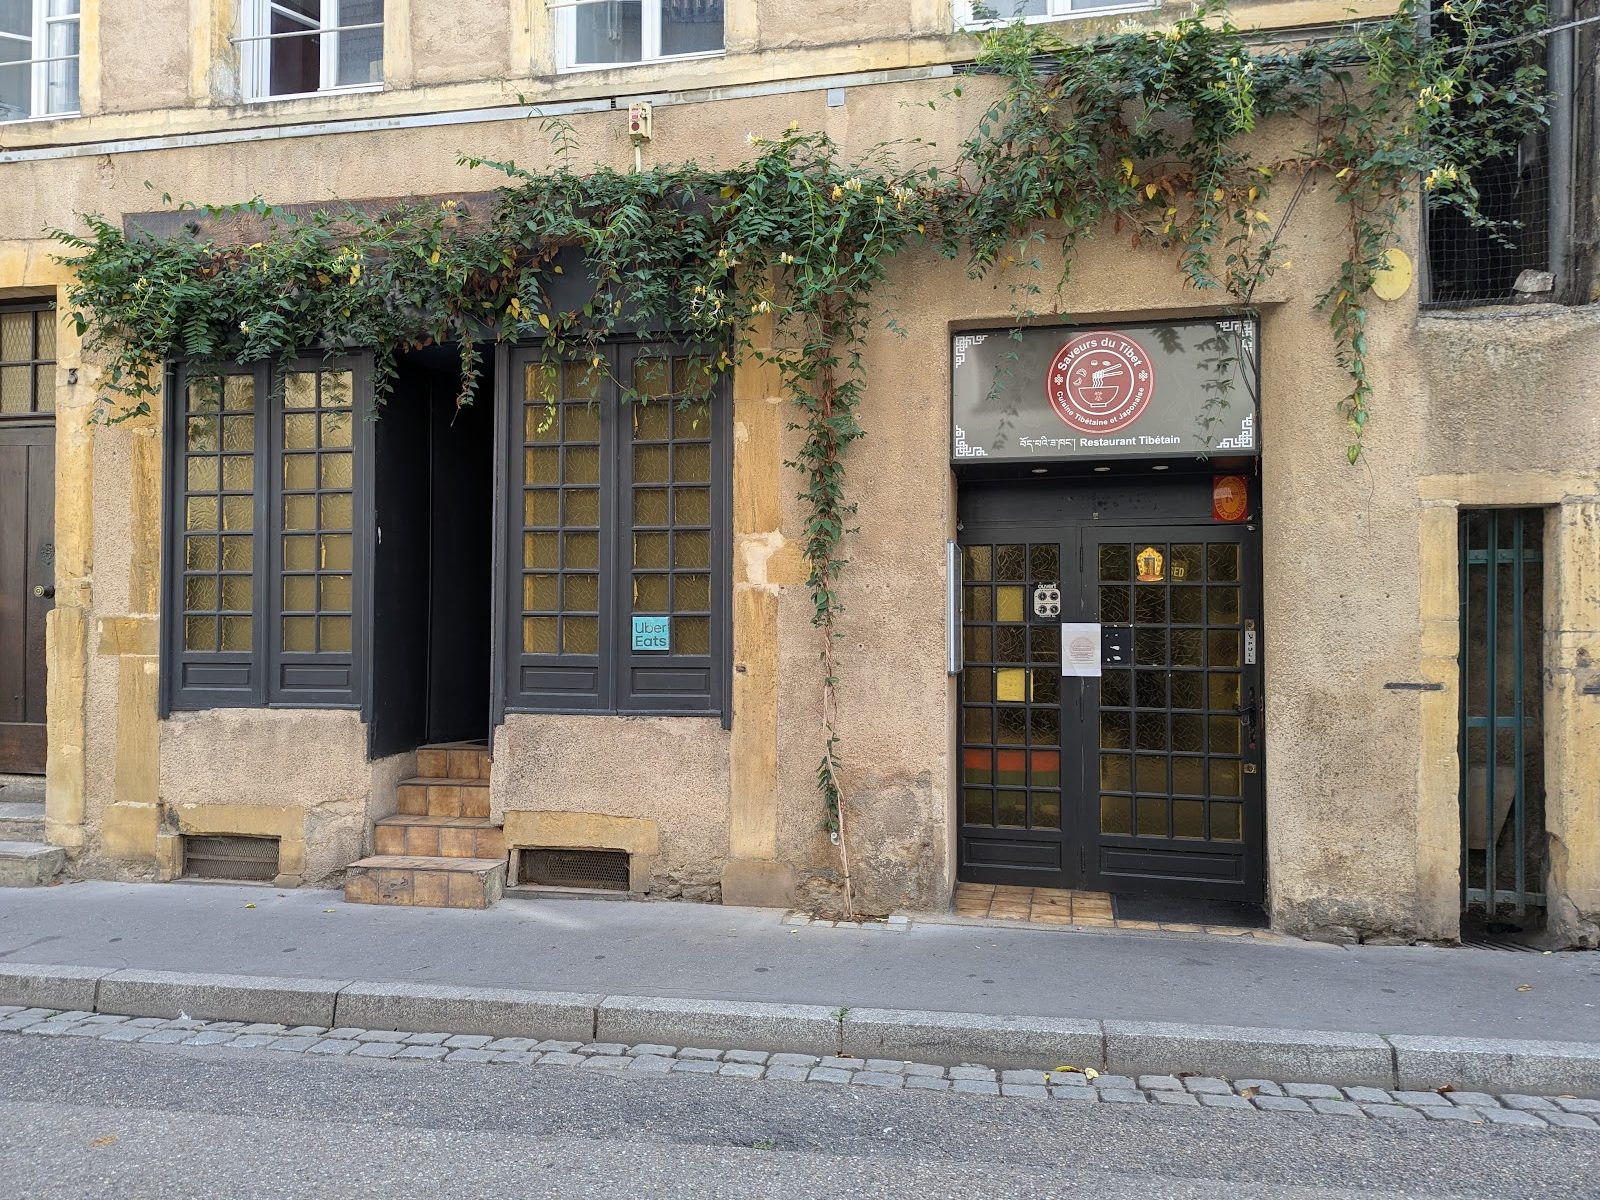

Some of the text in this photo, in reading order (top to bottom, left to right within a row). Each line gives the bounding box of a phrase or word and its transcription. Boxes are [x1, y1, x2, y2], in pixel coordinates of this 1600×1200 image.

[1057, 337, 1143, 371] Saveurs du Tibet
[67, 367, 79, 385] 3
[1056, 387, 1145, 426] Cuisine Tibétaine et Japonaise
[1079, 435, 1181, 447] Restaurant Tibétain
[635, 622, 667, 634] Uber
[635, 635, 667, 647] Eats
